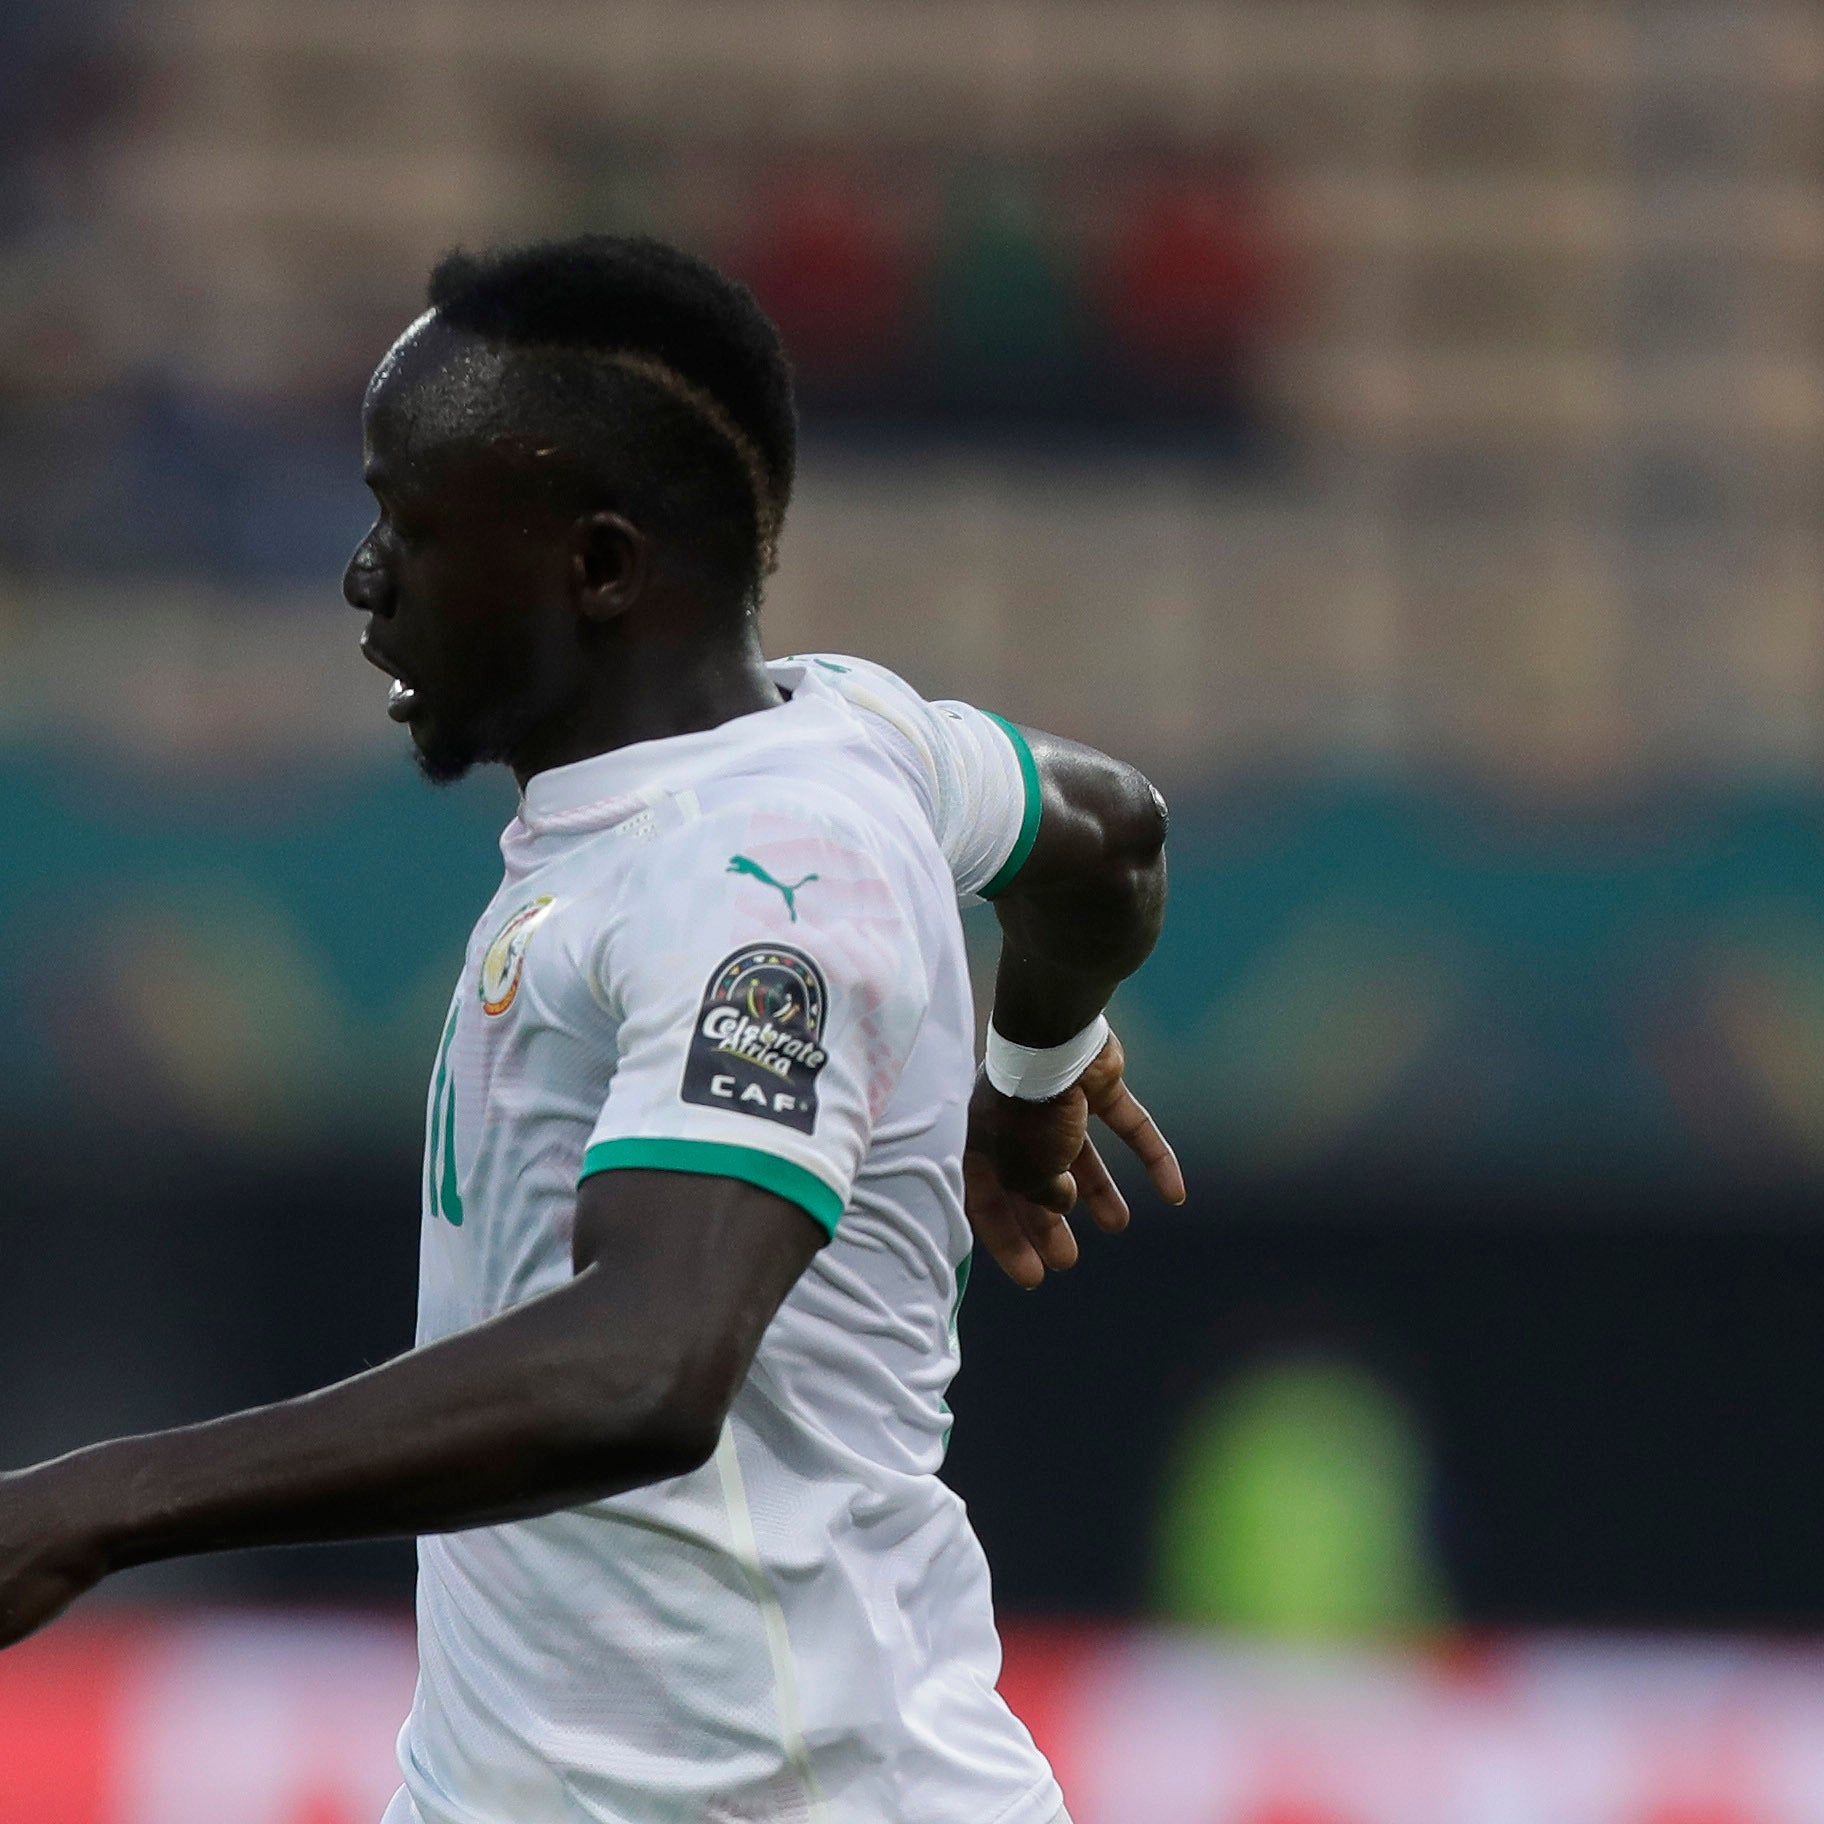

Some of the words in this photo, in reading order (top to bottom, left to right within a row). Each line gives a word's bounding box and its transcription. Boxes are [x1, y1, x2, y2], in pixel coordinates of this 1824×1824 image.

[702, 1006, 825, 1069] Celebrate
[719, 1034, 792, 1076] Africa
[710, 1073, 796, 1113] CAF
